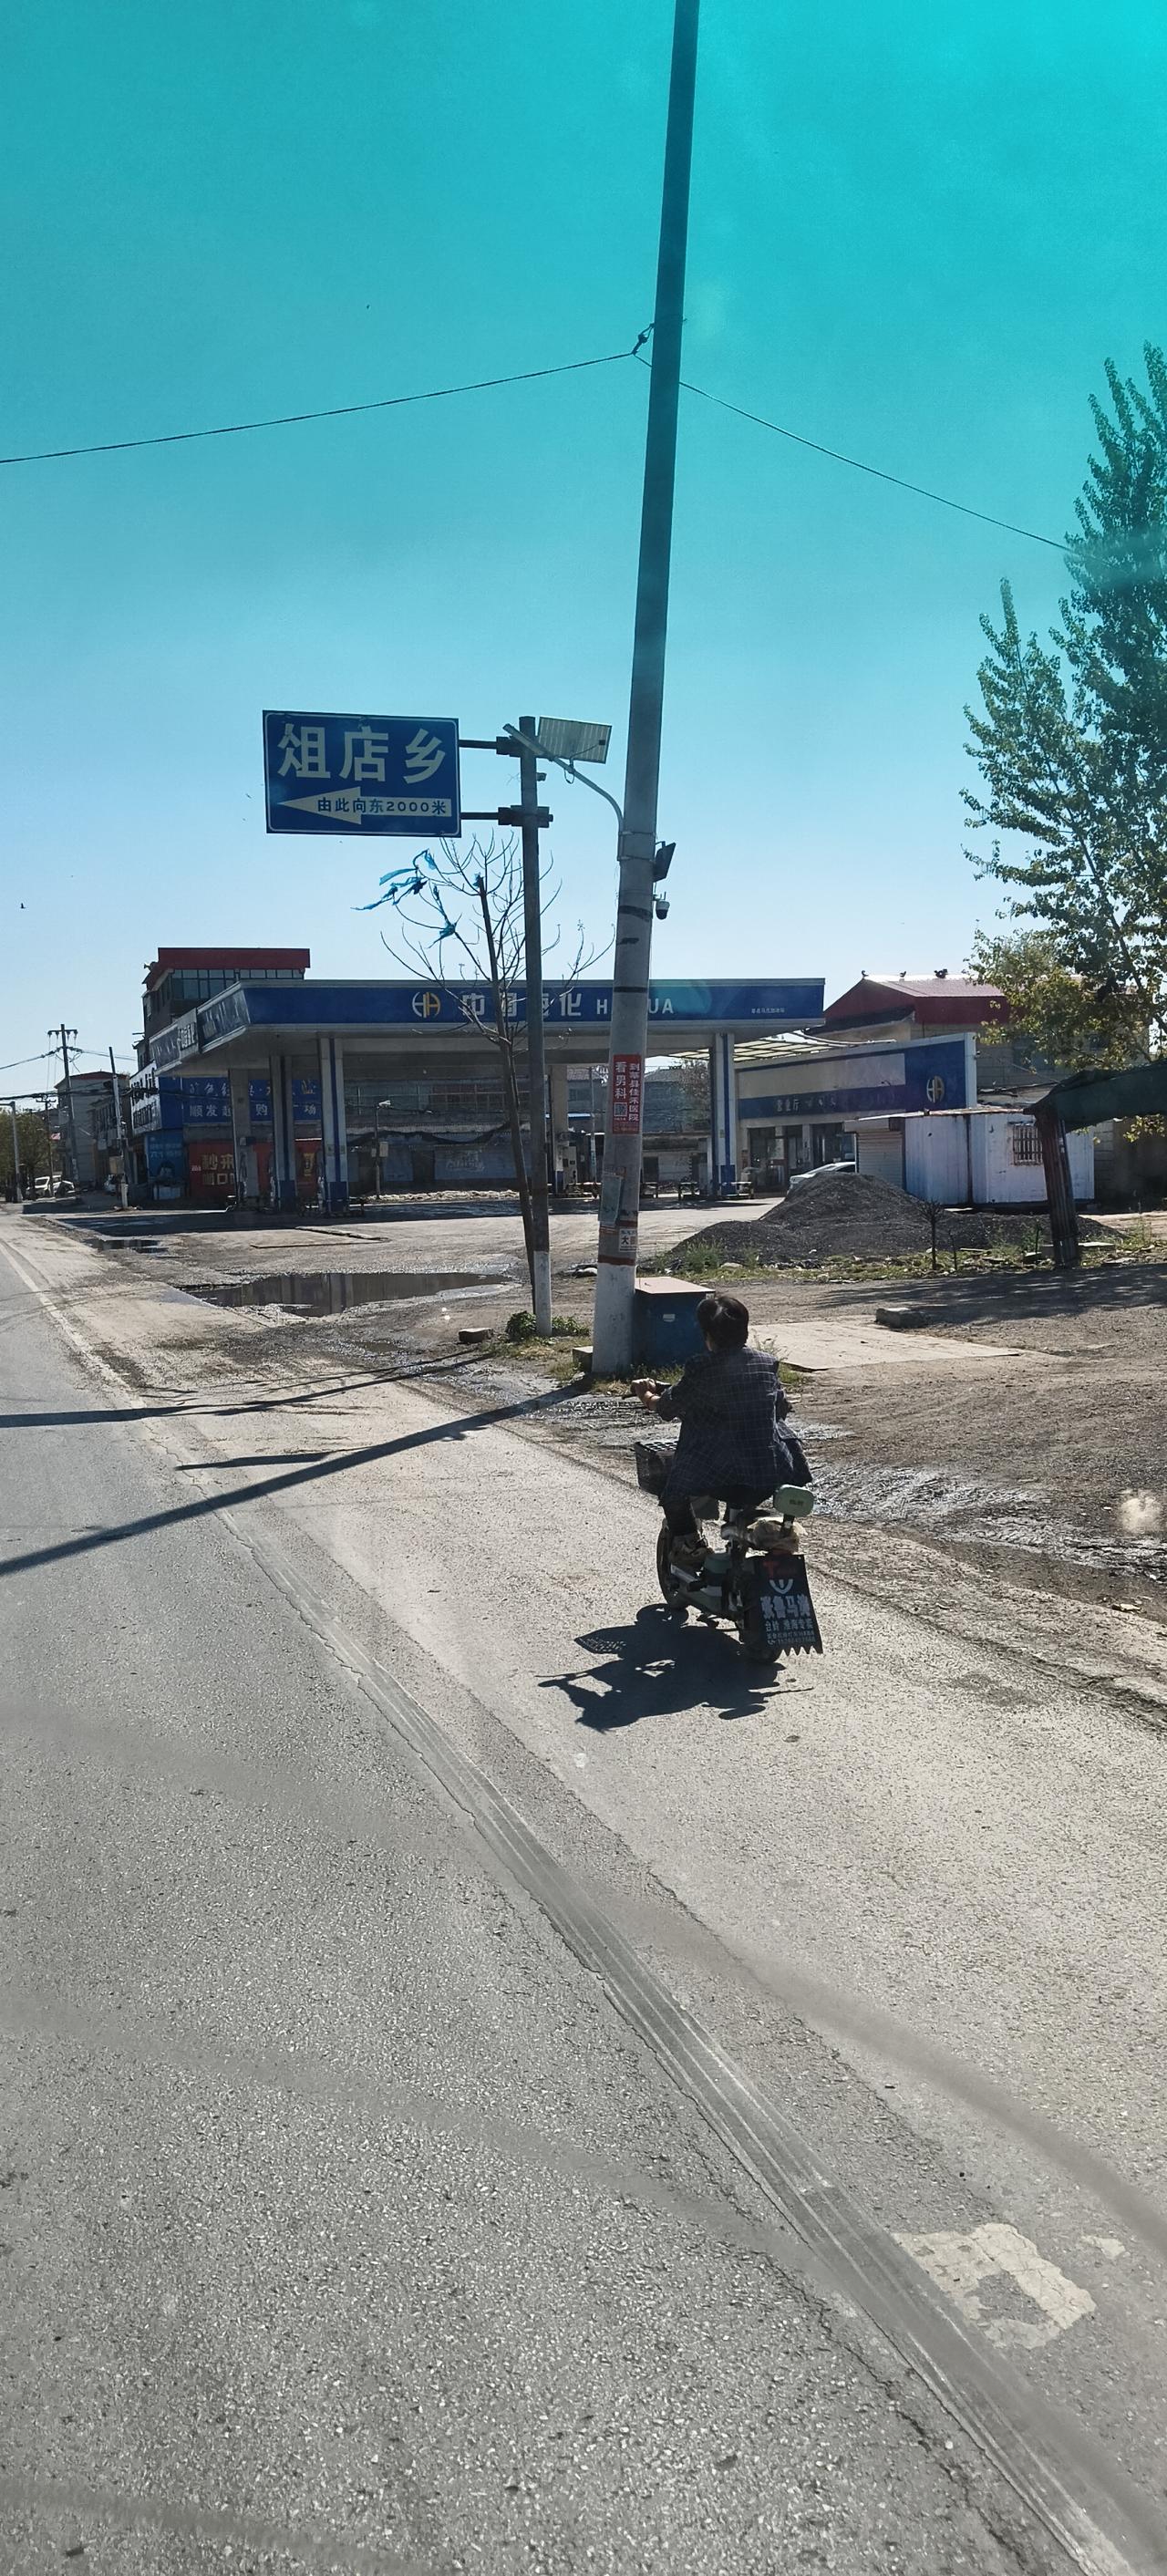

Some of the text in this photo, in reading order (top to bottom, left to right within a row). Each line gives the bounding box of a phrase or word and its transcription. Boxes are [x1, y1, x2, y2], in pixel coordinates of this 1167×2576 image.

[277, 723, 446, 784] 俎店乡
[317, 797, 447, 815] 由此向东2000米
[614, 1061, 627, 1100] 看男科
